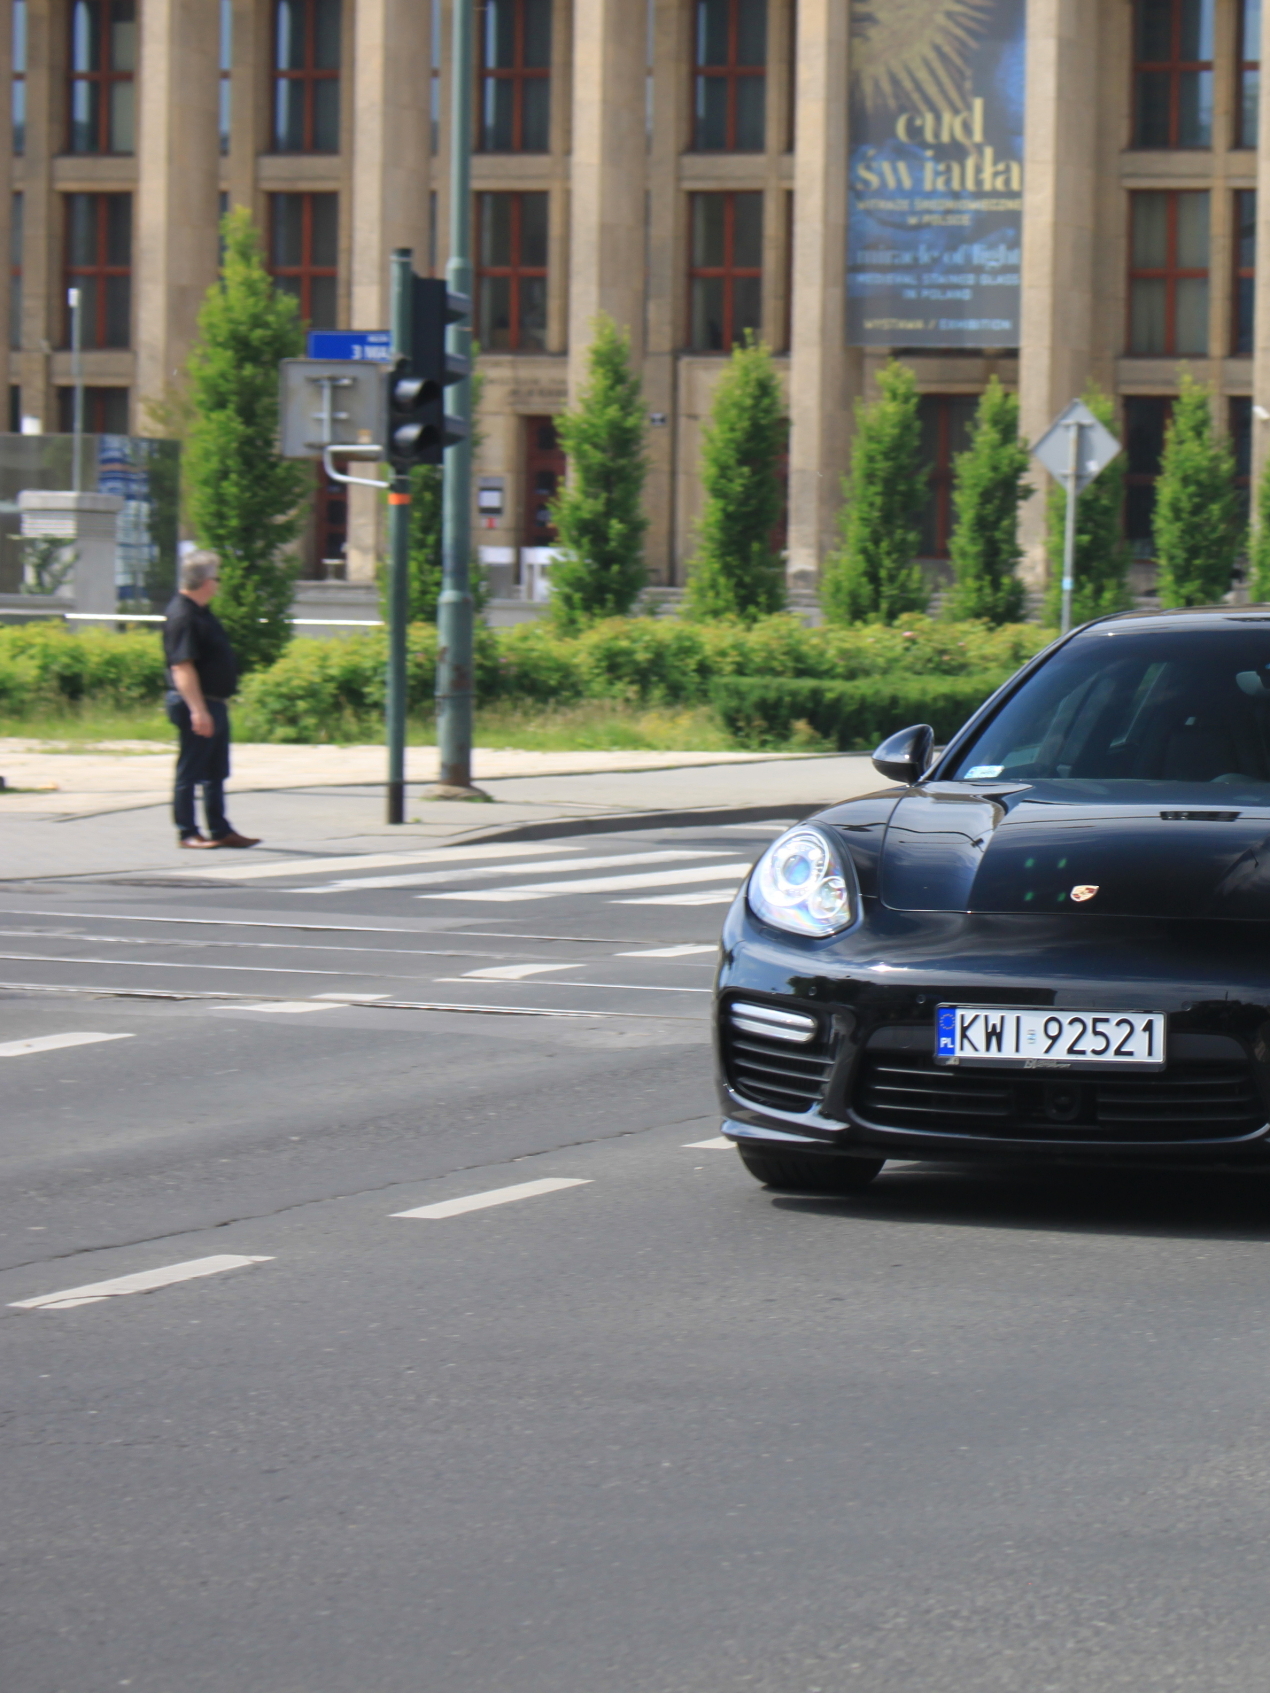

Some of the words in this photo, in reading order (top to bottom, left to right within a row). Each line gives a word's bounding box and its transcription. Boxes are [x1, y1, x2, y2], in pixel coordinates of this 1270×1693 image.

[895, 96, 984, 144] cud
[855, 145, 1022, 192] światła
[939, 1037, 955, 1048] PL
[959, 1013, 1021, 1053] KWI
[1043, 1016, 1154, 1057] 92521
